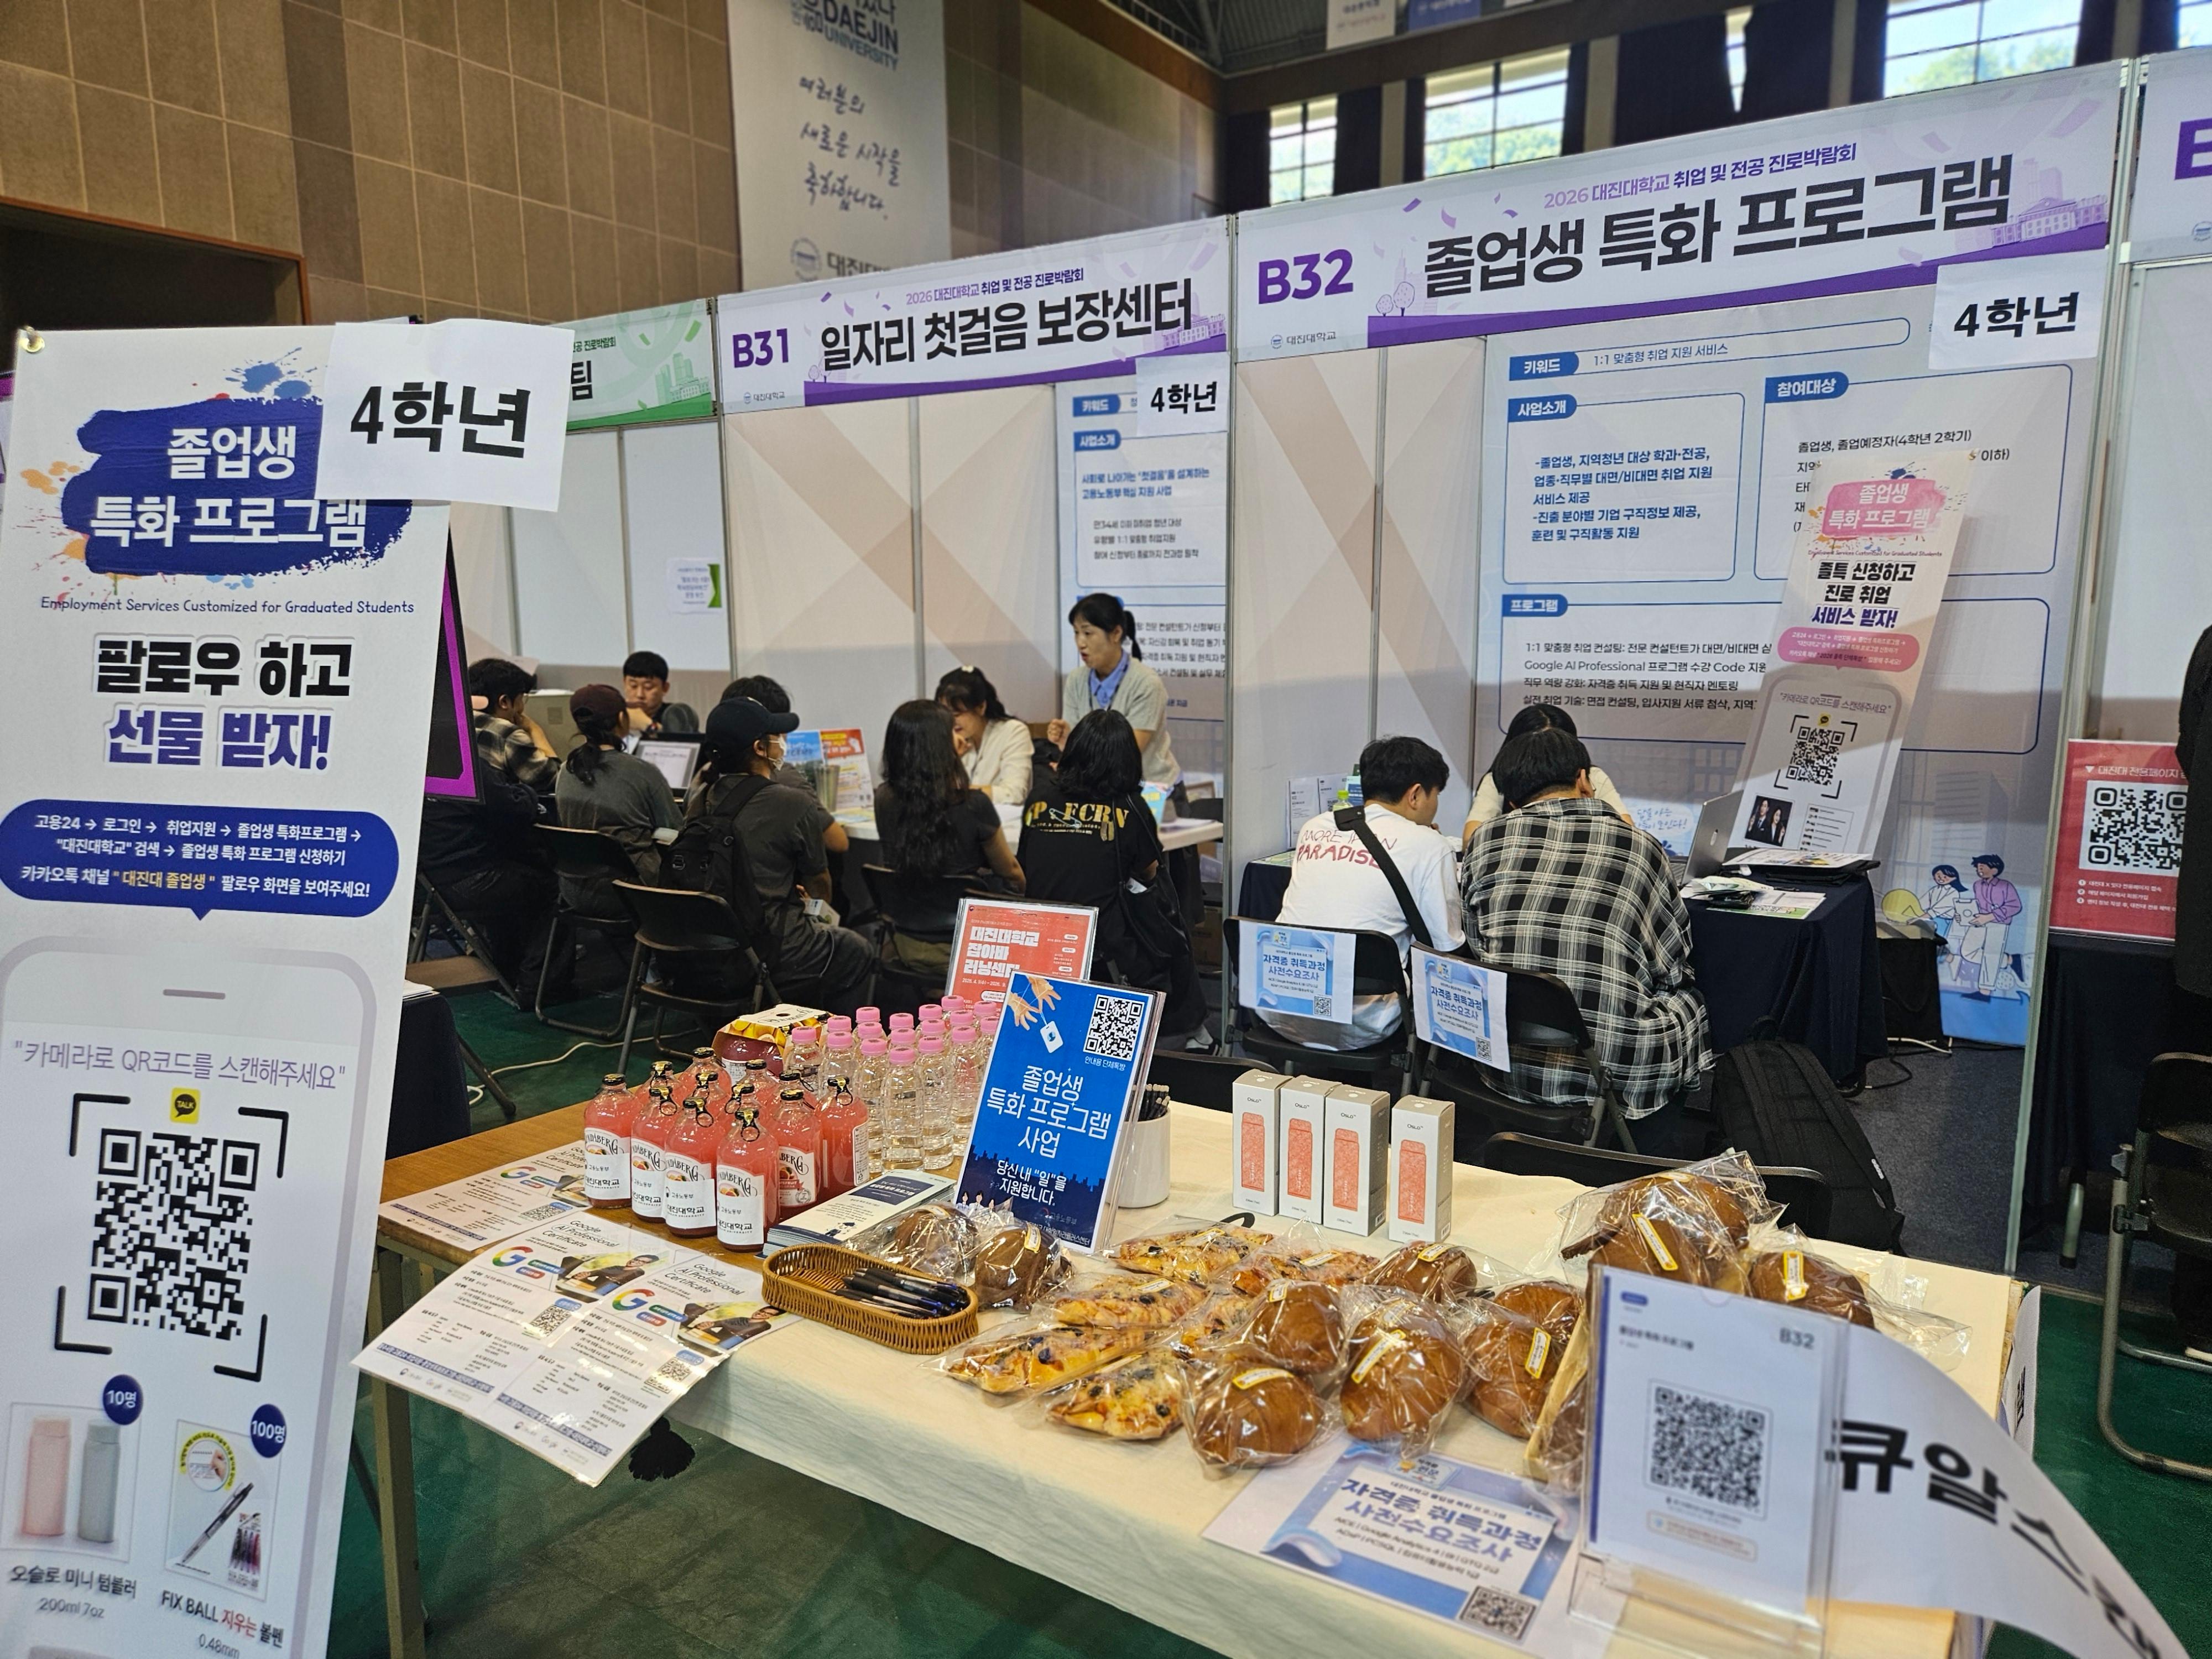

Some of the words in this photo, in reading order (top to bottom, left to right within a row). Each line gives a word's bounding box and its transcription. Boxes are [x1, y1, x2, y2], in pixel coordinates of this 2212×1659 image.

[823, 0, 899, 54] DAEJIN
[800, 121, 850, 159] 새로운
[855, 143, 901, 187] 시작을
[1543, 187, 1589, 210] 2026
[1592, 174, 1670, 202] 대진대학교
[1673, 167, 1707, 189] 취업
[1711, 164, 1726, 183] 및
[1730, 158, 1765, 180] 전공
[1768, 143, 1858, 173] 진로박람회
[1258, 248, 1354, 305] B32
[1425, 218, 1585, 299] 졸업생
[1599, 197, 1721, 272] 특화
[1733, 158, 2013, 257] 프로그램
[906, 290, 933, 305] 2026
[934, 283, 980, 302] 대진대학교
[981, 280, 1000, 295] 취업
[1002, 279, 1012, 293] 및
[1014, 275, 1033, 291] 전공
[1035, 268, 1084, 288] 진로박람회
[732, 328, 789, 368] B31
[821, 316, 915, 372] 일자리
[924, 302, 1027, 361] 첫걸음
[1037, 279, 1193, 346] 보장센터
[1954, 291, 2079, 338] 4학년
[584, 336, 617, 352] 진로박람회
[1286, 331, 1337, 345] 대진대학교
[1593, 354, 1610, 366] 1:1
[1613, 351, 1645, 365] 맞춤형
[1647, 349, 1668, 362] 취업
[1671, 346, 1693, 359] 지원
[1695, 343, 1729, 358] 서비스
[1524, 358, 1561, 374] 키워드
[1150, 380, 1218, 415] 4학년
[1777, 378, 1837, 398] 참여대상
[350, 380, 531, 458] 4학년
[1517, 401, 1566, 418] 사업소개
[1079, 433, 1116, 447] 사업소개
[1798, 440, 1834, 453] 졸업생,
[1934, 429, 1973, 444] 2학기)
[167, 425, 298, 480] 졸업생
[1579, 453, 1625, 467] 지역청년
[1627, 451, 1651, 464] 대상
[1595, 471, 1658, 486] 대면/비대면
[1661, 468, 1685, 482] 취업
[1688, 466, 1713, 479] 지원
[1138, 486, 1155, 497] 지원
[1156, 485, 1172, 497] 사업
[1533, 493, 1566, 507] 서비스
[1568, 491, 1590, 505] 제공
[1859, 482, 1909, 504] 졸업생
[91, 495, 181, 547] 특화
[189, 496, 368, 548] 프로그램
[1562, 509, 1595, 523] 분야별
[1598, 508, 1620, 521] 기업
[1623, 506, 1670, 521] 구직정보
[1828, 509, 1860, 528] 특화
[1861, 508, 1931, 529] 프로그램
[1531, 529, 1554, 542] 훈련
[1557, 529, 1567, 541] 및
[1569, 528, 1614, 541] 구직활동
[1617, 526, 1640, 540] 지원
[1851, 562, 1916, 582] 신청하고
[40, 596, 122, 613] Employment
[126, 598, 180, 612] Services
[183, 599, 258, 613] Customized
[262, 600, 282, 613] for
[285, 600, 353, 614] Graduated
[357, 601, 415, 614] Students
[1824, 585, 1856, 603] 진로
[1859, 585, 1892, 604] 취업
[1510, 599, 1558, 613] 프로그램
[1811, 607, 1856, 625] 서비스
[1859, 608, 1898, 629] 받자!
[1525, 643, 1540, 653] 1:1
[1543, 643, 1572, 654] 맞춤형
[1574, 643, 1592, 654] 취업
[1627, 643, 1647, 654] 전문
[1650, 643, 1700, 654] 컨설턴트가
[1702, 643, 1760, 655] 대면/비대면
[96, 639, 241, 696] 팔로우
[258, 640, 353, 698] 하고
[1524, 660, 1564, 672] Google
[1565, 661, 1577, 670] AI
[1578, 660, 1646, 671] Professional
[1647, 661, 1688, 673] 프로그램
[1690, 662, 1712, 673] 수강
[1713, 662, 1746, 672] Code
[1524, 677, 1542, 688] 직무
[1544, 677, 1562, 688] 역량
[1588, 679, 1616, 690] 자격증
[1618, 680, 1637, 690] 취득
[1640, 679, 1660, 690] 지원
[1674, 680, 1705, 691] 현직자
[1707, 681, 1739, 691] 멘토링
[1587, 697, 1605, 707] 면접
[1642, 698, 1682, 709] 입사지원
[1684, 698, 1705, 709] 서류
[108, 708, 204, 766] 선물
[221, 712, 332, 771] 받자!
[34, 815, 82, 831] 고용24
[102, 817, 142, 834] 로그인
[166, 820, 216, 837] 취업지원
[238, 822, 274, 839] 졸업생
[276, 824, 348, 842] 특화프로그램
[1301, 830, 1343, 843] MORE
[56, 838, 132, 855] "대진대학교"
[134, 841, 160, 857] 검색
[181, 843, 219, 860] 졸업생
[221, 845, 247, 861] 특화
[248, 847, 296, 864] 프로그램
[299, 848, 346, 866] 신청하기
[21, 865, 80, 884] 카카오톡
[82, 868, 110, 885] 채널
[221, 875, 260, 893] 팔로우
[263, 877, 302, 895] 화면을
[304, 879, 371, 899] 보여주세요!
[969, 925, 1041, 948] 대진대학교
[967, 942, 1010, 962] 잡아바
[1262, 953, 1288, 966] 자격증
[1291, 958, 1326, 972] 취득과정
[1268, 966, 1320, 982] 사전수요조사
[1431, 985, 1452, 1001] 자격증
[1453, 993, 1483, 1011] 취득과정
[14, 1040, 117, 1072] "카메라로
[121, 1048, 214, 1080] QR코드를
[218, 1055, 346, 1091] 스캔해주세요"
[1021, 1064, 1084, 1103] 졸업생
[986, 1086, 1027, 1119] 특화
[1027, 1097, 1113, 1141] 프로그램
[1018, 1125, 1061, 1159] 사업
[997, 1160, 1019, 1178] 당신
[1019, 1166, 1032, 1182] 내
[999, 1177, 1056, 1207] 지원합니다.
[570, 1220, 602, 1233] Google
[694, 1263, 727, 1277] Google
[665, 1272, 712, 1293] Certificate
[688, 1270, 745, 1296] Professional
[1778, 1327, 1815, 1350] B32
[106, 1389, 137, 1410] 10명
[251, 1420, 286, 1443] 100명
[1340, 1478, 1421, 1514] 자격증
[1427, 1505, 1543, 1552] 취득과정
[1344, 1500, 1513, 1562] 사전수요조사
[10, 1565, 60, 1585] 오슬로
[65, 1568, 94, 1589] 미니
[98, 1573, 138, 1599] 텀블러
[161, 1590, 182, 1610] FIX
[186, 1599, 219, 1623] BALL
[221, 1609, 258, 1639] 지우는
[260, 1622, 284, 1649] 볼펜
